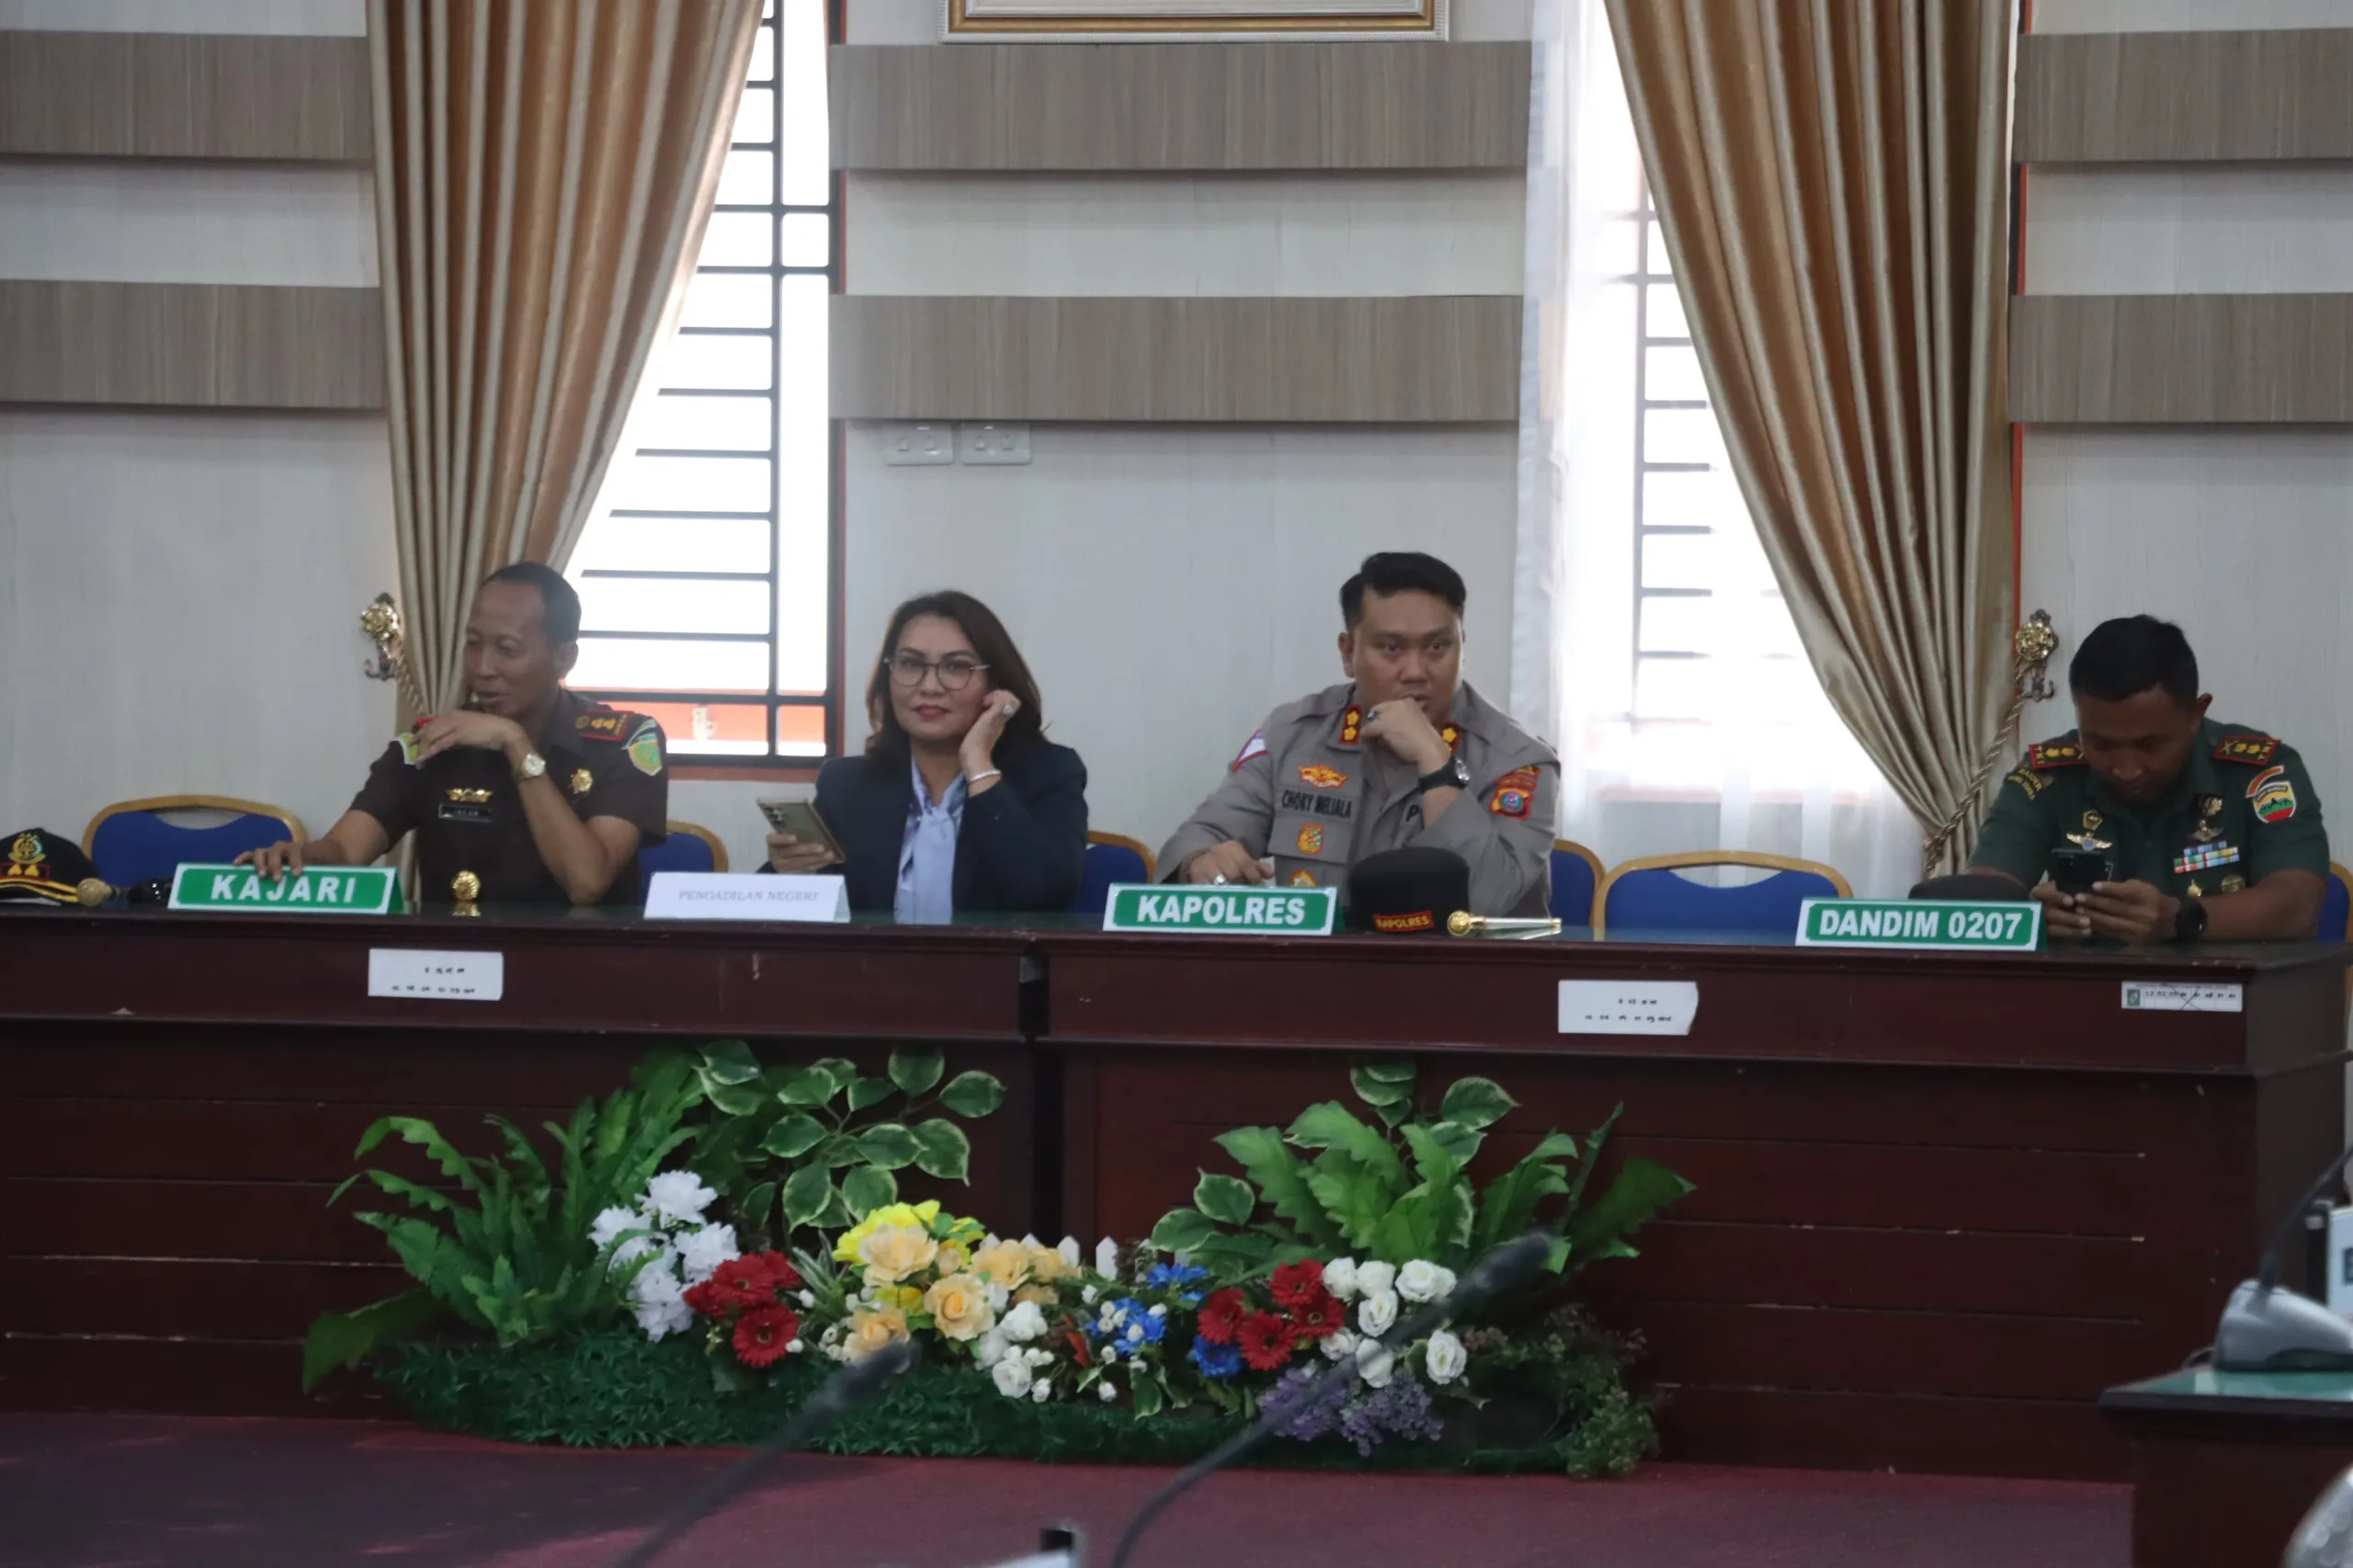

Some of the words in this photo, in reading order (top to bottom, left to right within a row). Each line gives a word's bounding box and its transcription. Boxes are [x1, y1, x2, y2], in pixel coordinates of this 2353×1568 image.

[210, 874, 357, 903] KAJARI
[678, 890, 764, 902] PENGADILAN
[767, 892, 820, 903] NEGERI
[1136, 894, 1307, 926] KAPOLRES
[1375, 915, 1430, 928] KAPOLRES
[1818, 909, 1939, 938] DANDIM
[1948, 912, 2023, 940] 0207
